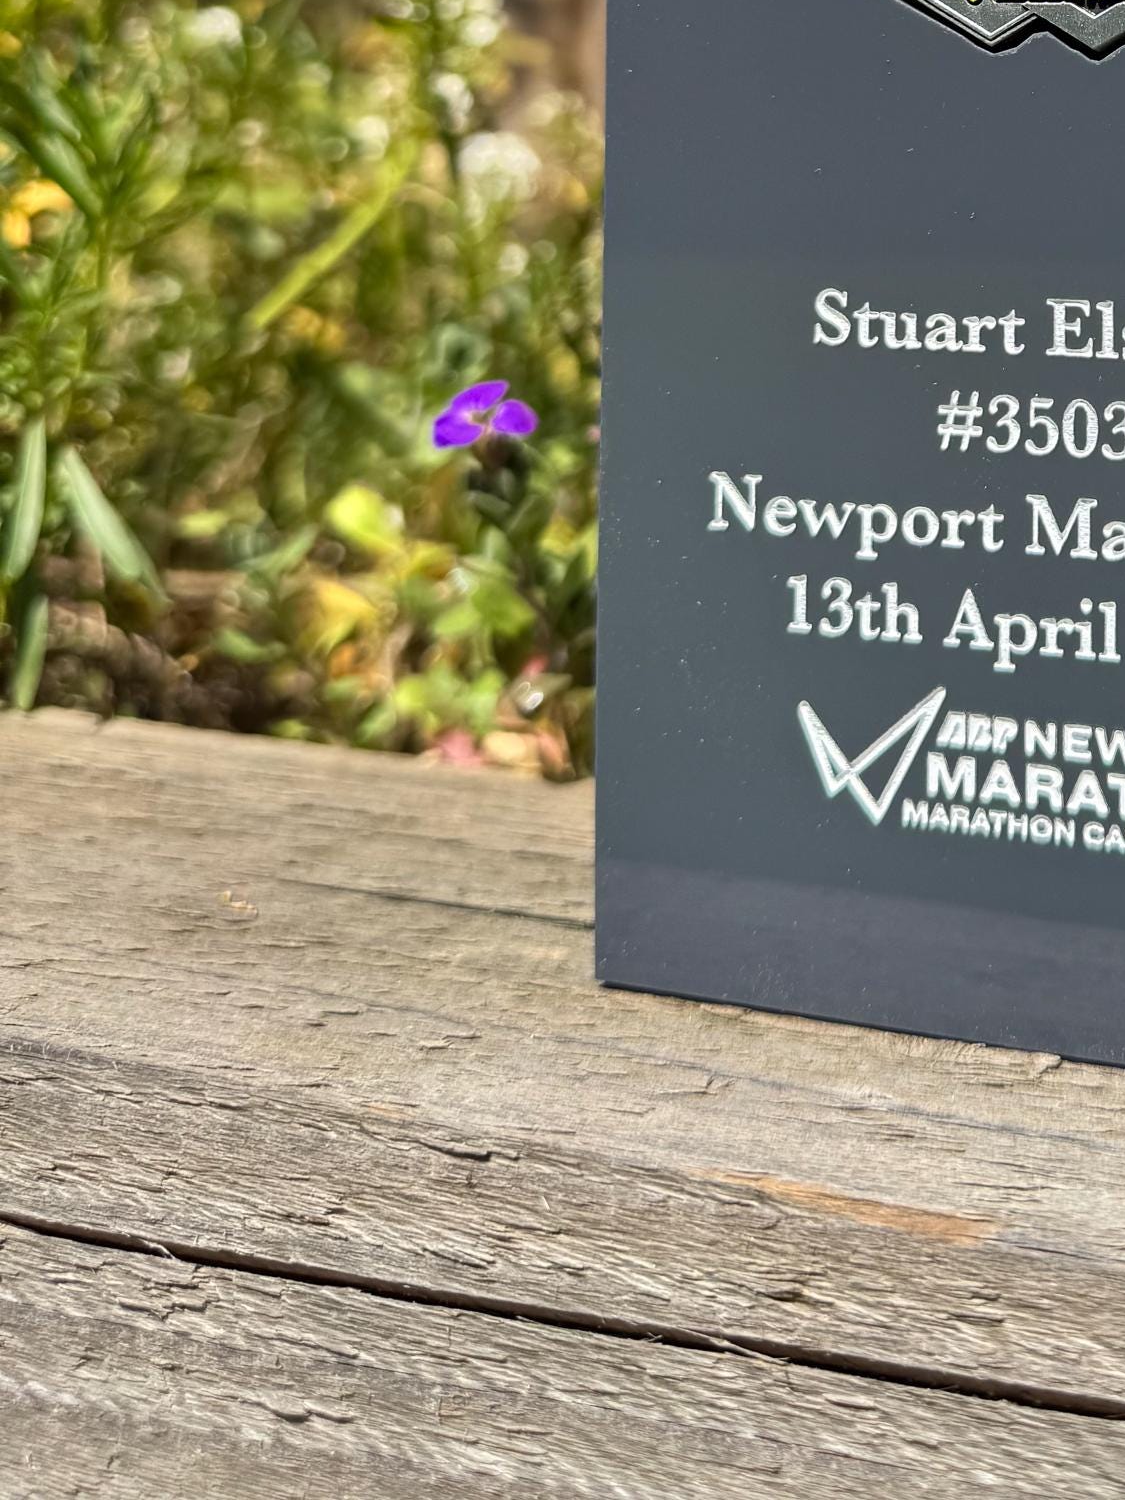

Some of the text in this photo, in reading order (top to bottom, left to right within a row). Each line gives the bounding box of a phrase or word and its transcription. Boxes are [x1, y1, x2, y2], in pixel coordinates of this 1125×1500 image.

[812, 288, 1026, 355] Stuart
[707, 471, 1005, 560] Newport
[785, 574, 923, 644] 13th
[942, 588, 1121, 673] April
[901, 798, 1076, 847] MARATHON
